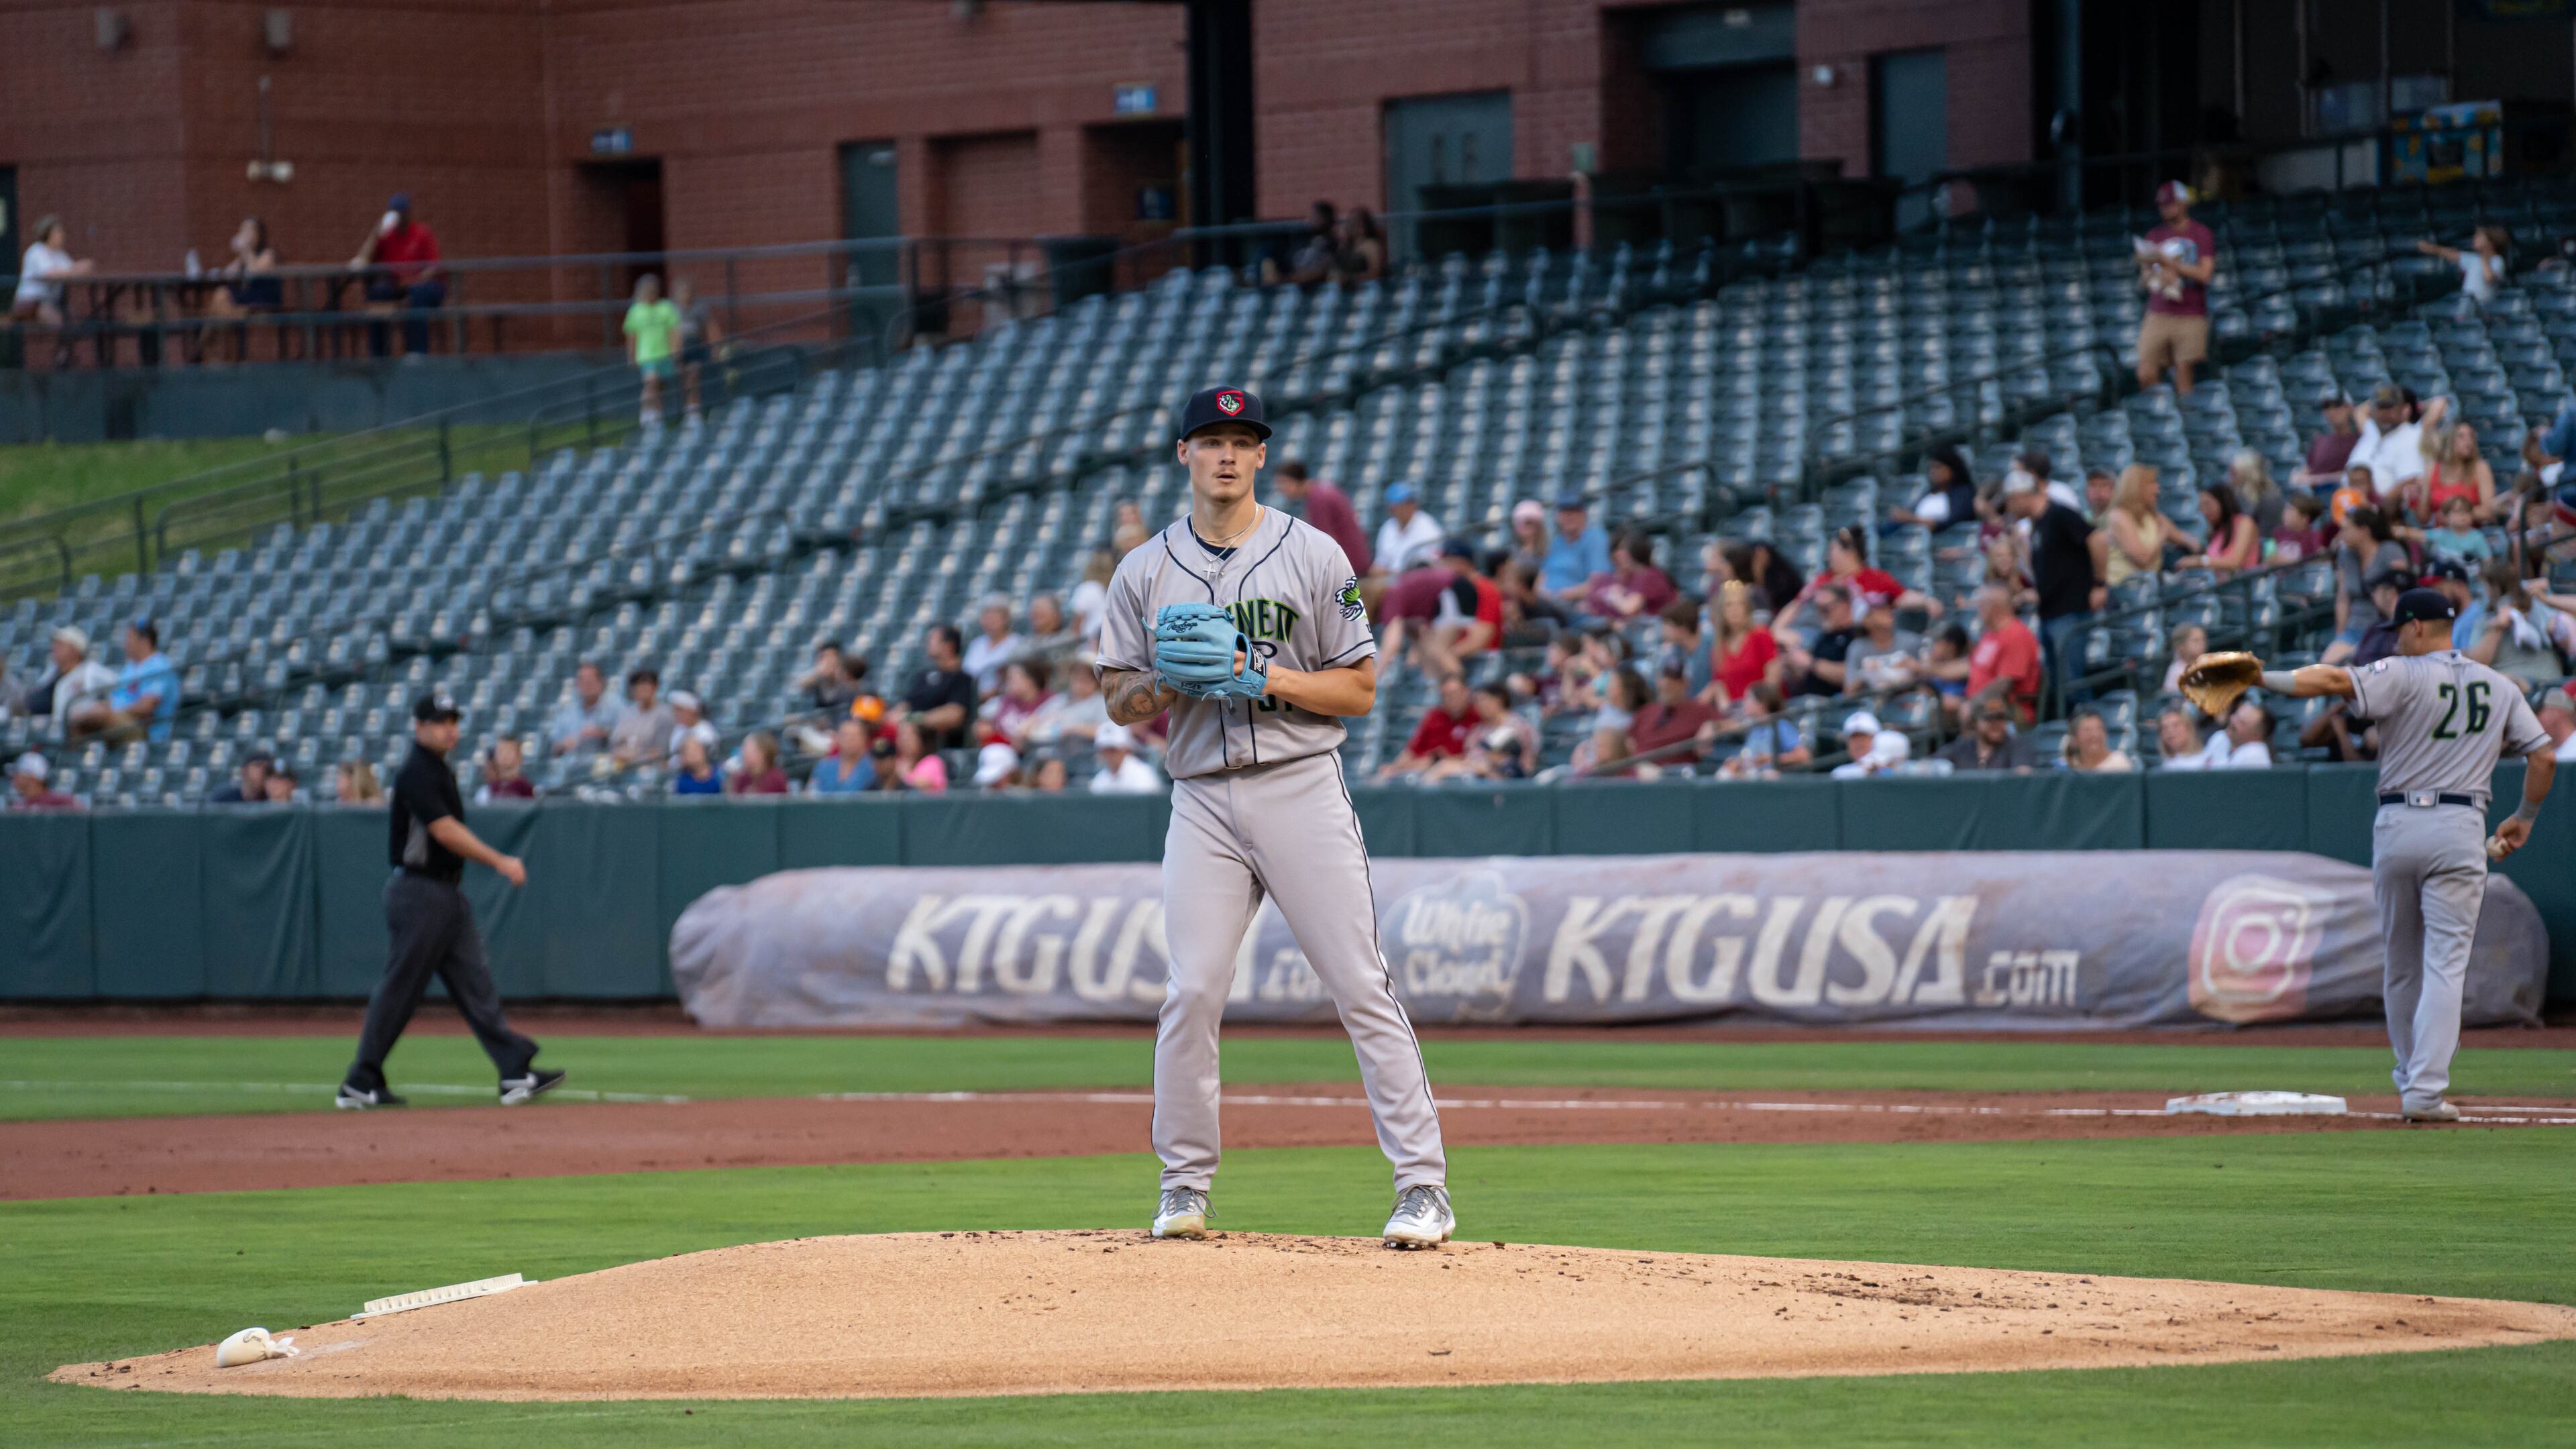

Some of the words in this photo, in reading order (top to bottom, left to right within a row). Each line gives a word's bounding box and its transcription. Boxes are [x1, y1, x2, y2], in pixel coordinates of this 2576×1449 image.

[2432, 681, 2491, 741] 26
[1403, 894, 1512, 954] White
[1405, 947, 1507, 996] Cloud
